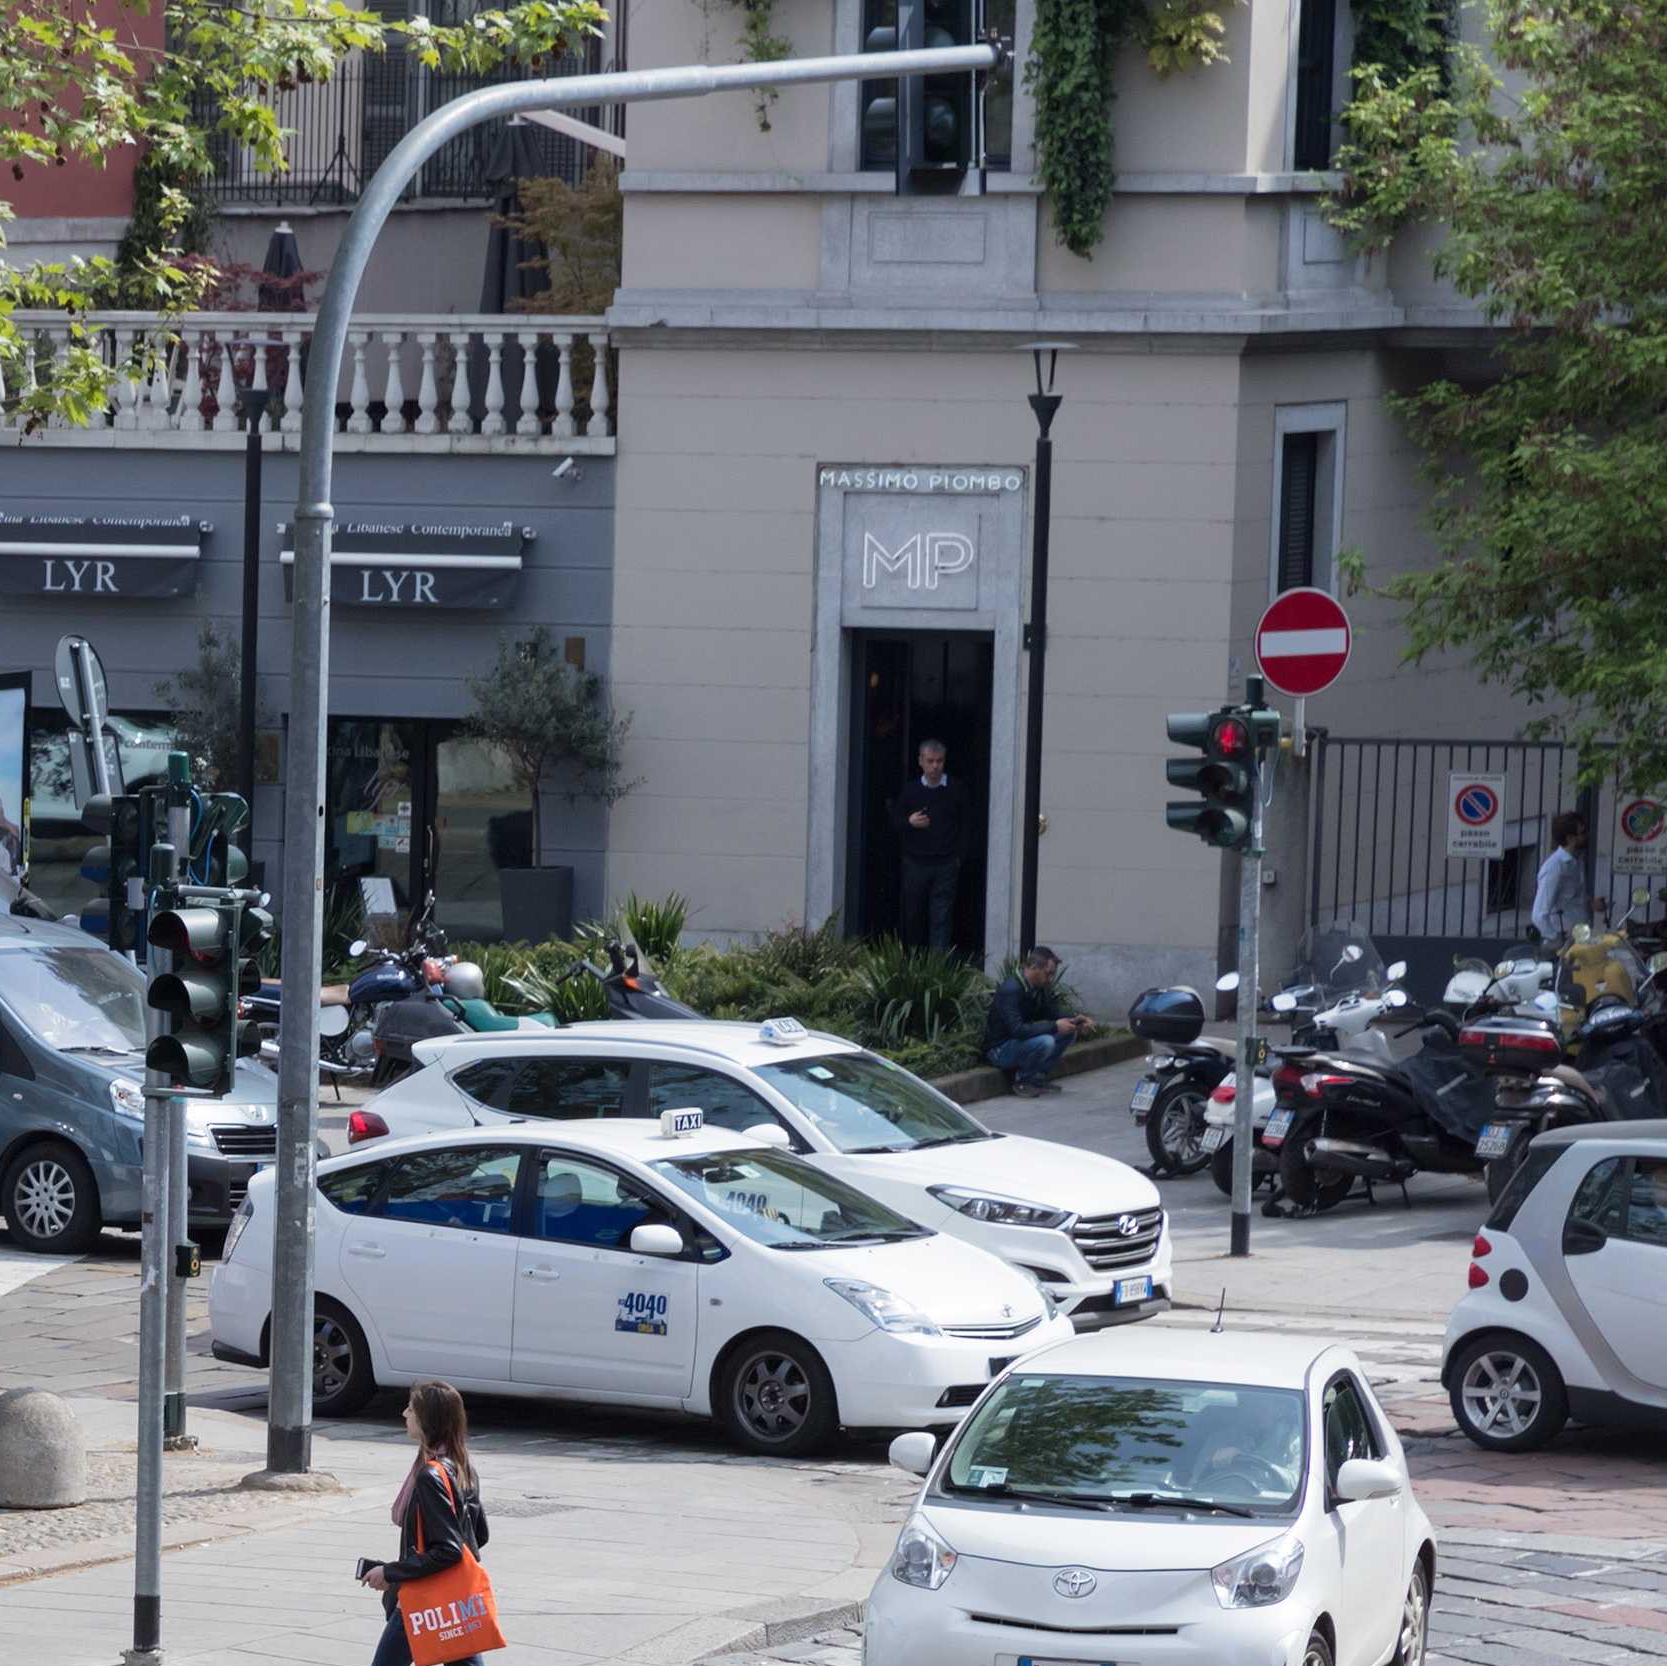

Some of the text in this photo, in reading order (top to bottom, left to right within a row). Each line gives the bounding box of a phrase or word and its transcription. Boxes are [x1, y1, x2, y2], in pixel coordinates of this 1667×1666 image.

[820, 471, 1021, 490] MASSIMO PIOMBO
[347, 522, 404, 535] Libanese
[411, 521, 513, 540] Contemporanea
[863, 530, 974, 590] MP
[43, 559, 120, 592] LYR
[360, 570, 440, 603] LYR
[675, 1114, 702, 1130] TAXI
[624, 1292, 667, 1320] 4040
[409, 1594, 487, 1635] POLIMI
[438, 1626, 465, 1641] SINCE
